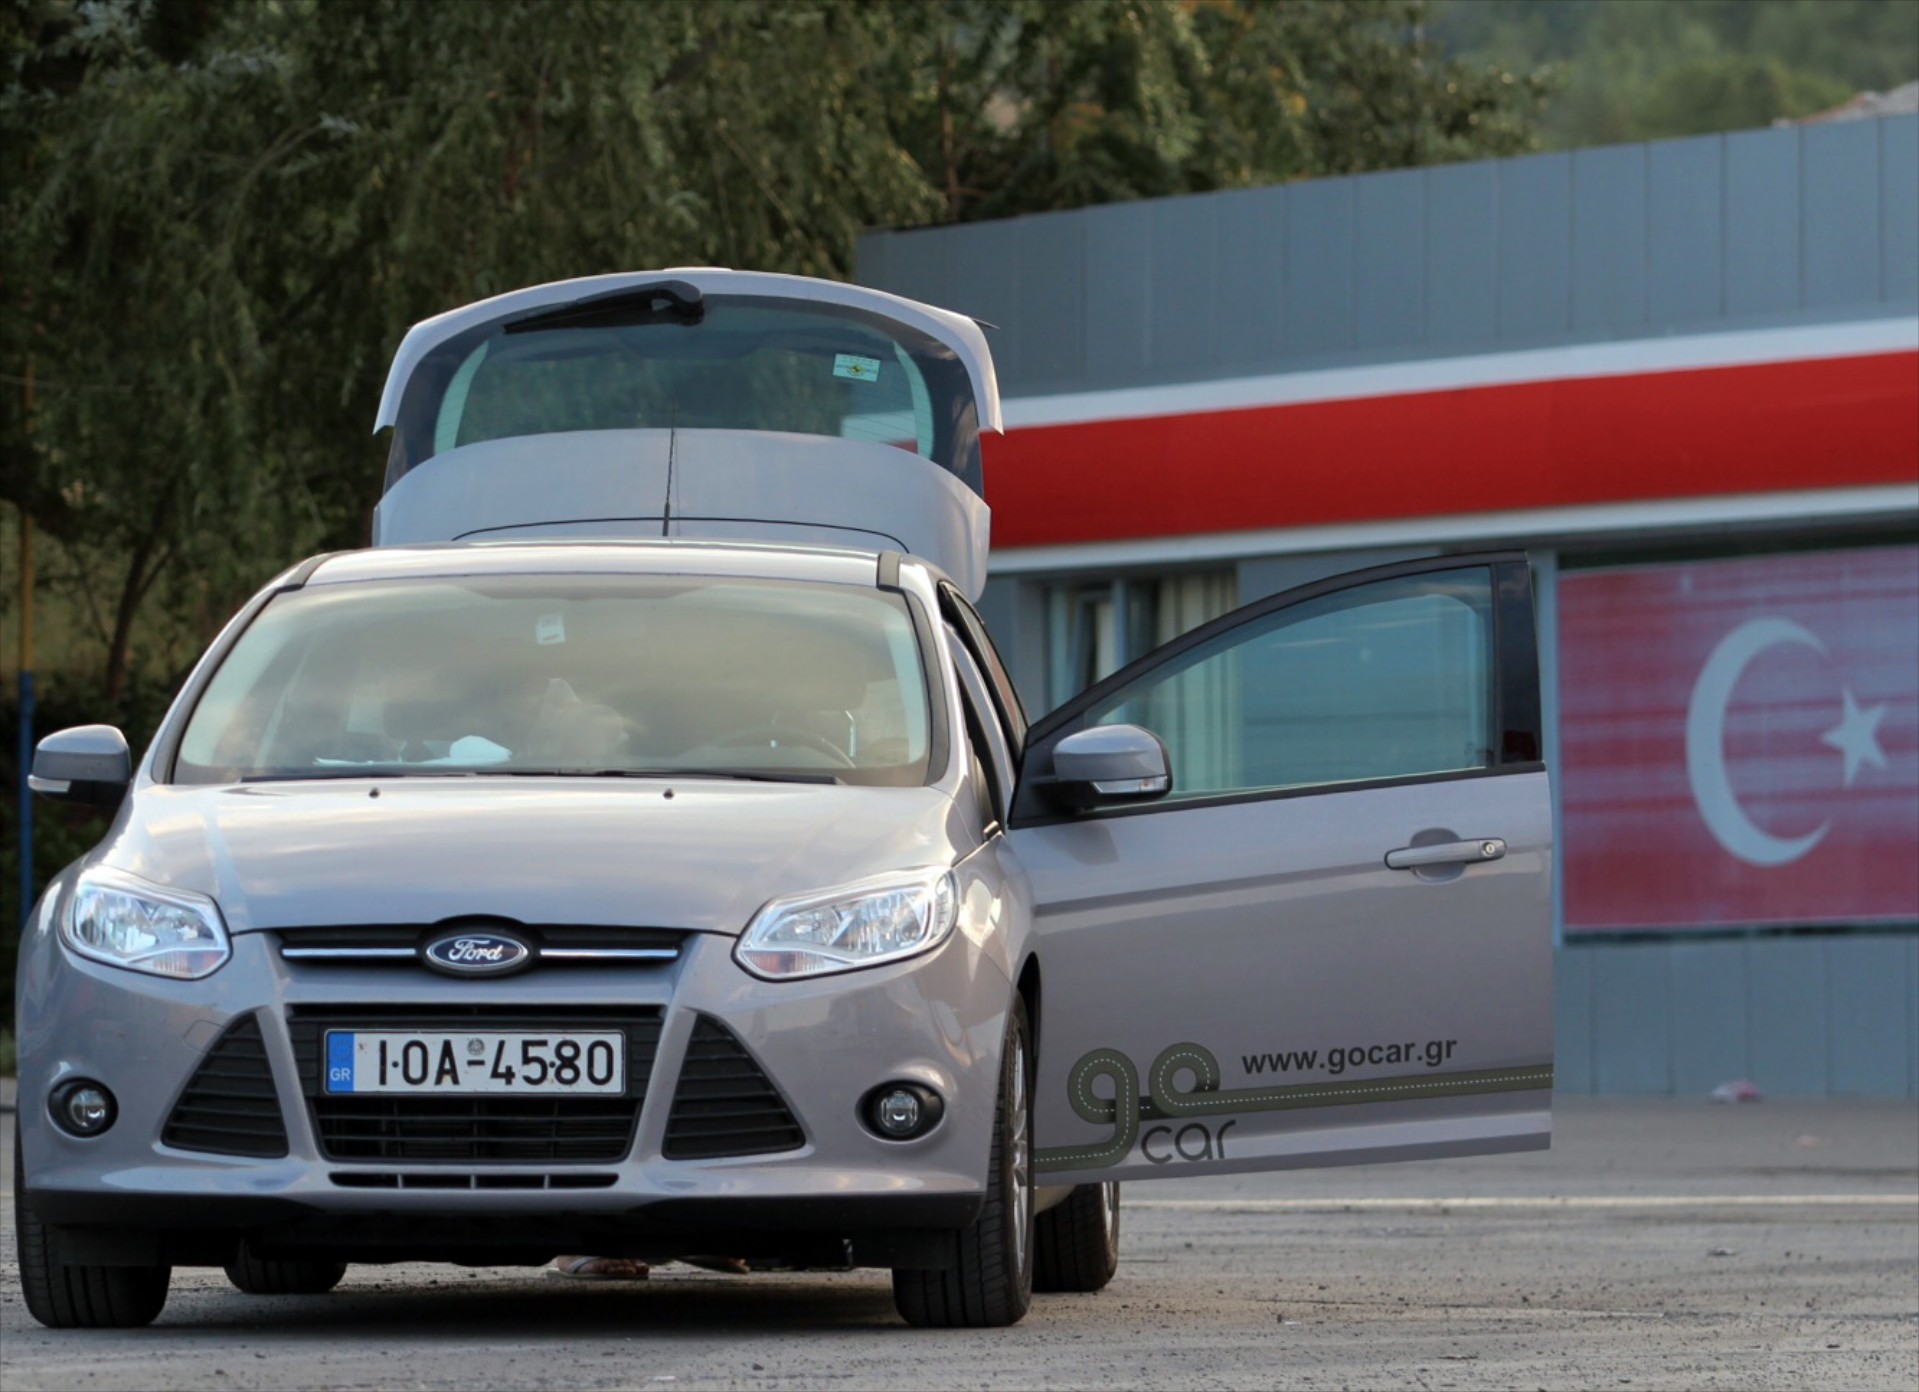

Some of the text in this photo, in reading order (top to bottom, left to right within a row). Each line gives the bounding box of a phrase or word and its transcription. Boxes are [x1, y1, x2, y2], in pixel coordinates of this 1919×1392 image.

[448, 939, 503, 961] Ford
[1241, 1037, 1458, 1075] www.gocar.gr
[329, 1068, 351, 1082] GR
[1140, 1119, 1237, 1164] car
